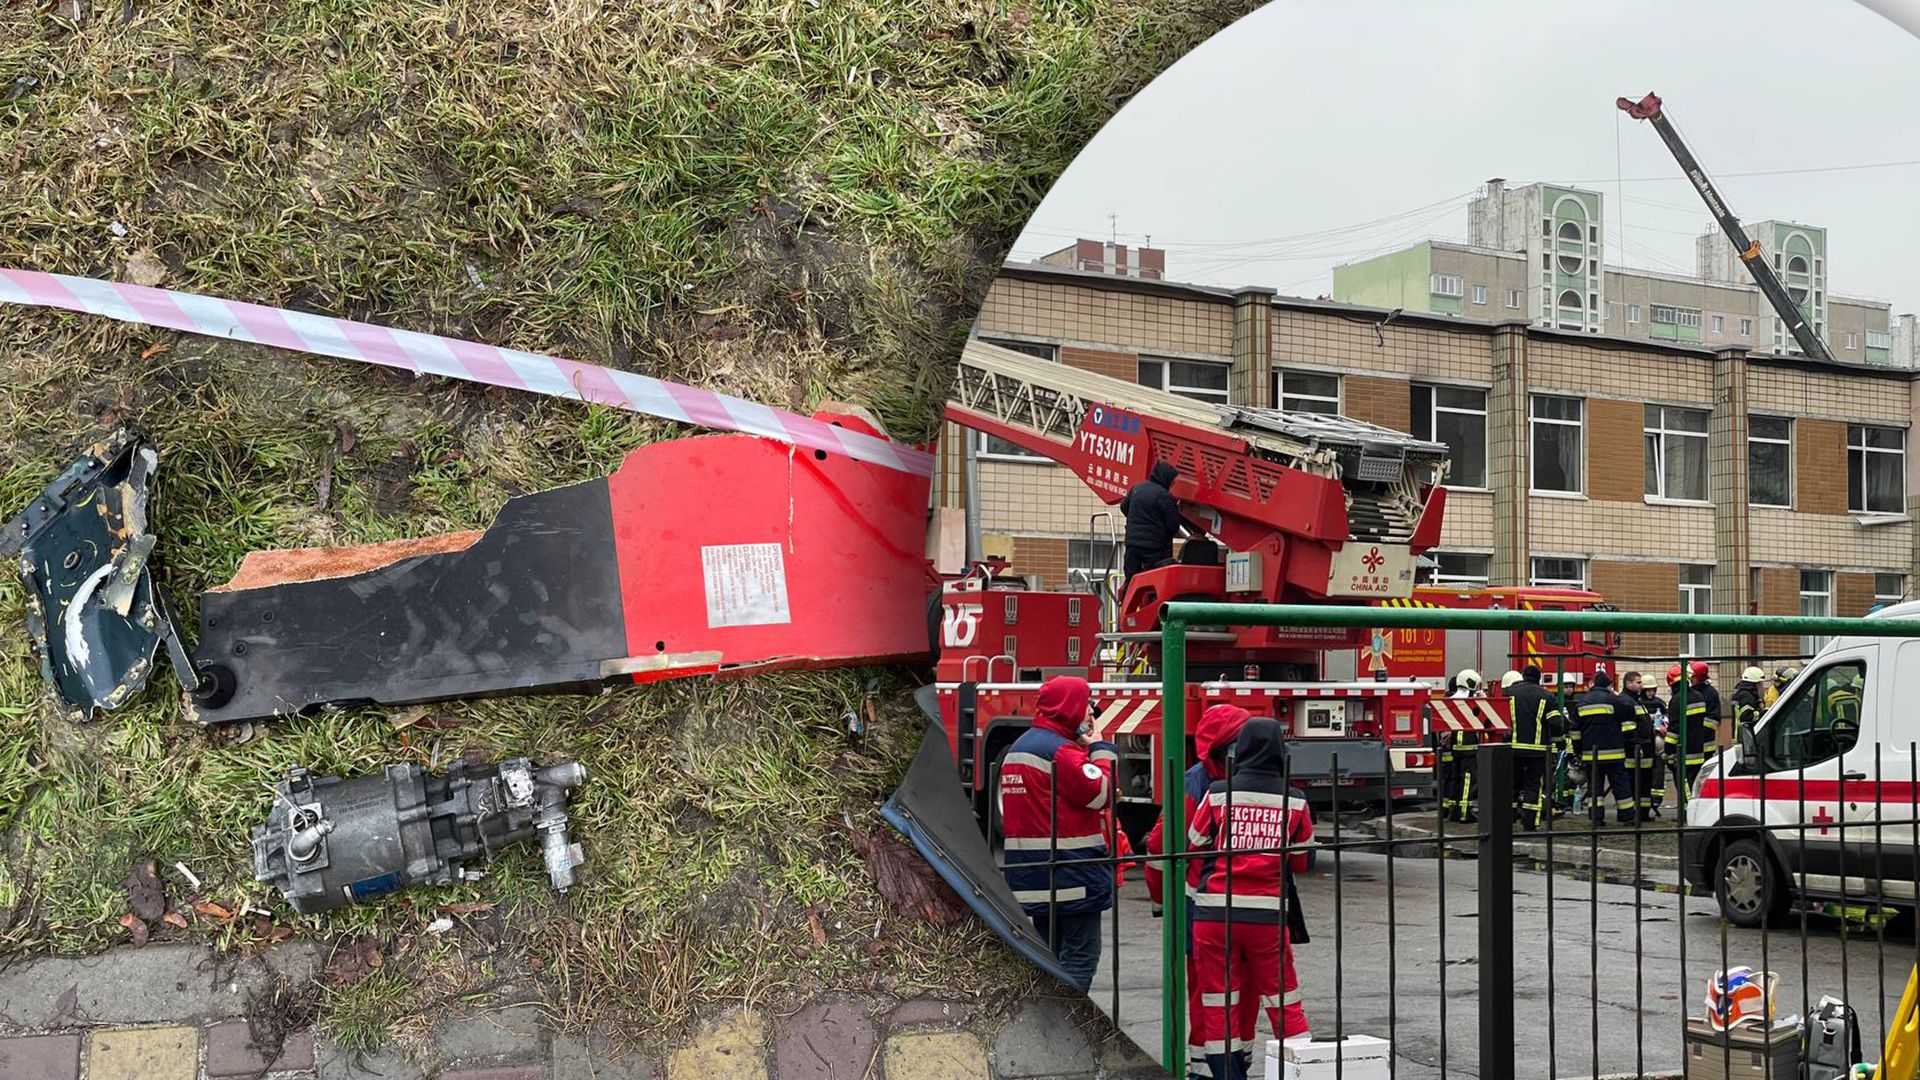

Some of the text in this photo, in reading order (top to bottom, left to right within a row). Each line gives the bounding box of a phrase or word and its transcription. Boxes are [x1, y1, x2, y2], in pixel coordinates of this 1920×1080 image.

[1080, 430, 1135, 466] YT53/M1
[1351, 583, 1388, 592] CHINA AID
[1401, 628, 1417, 644] 101
